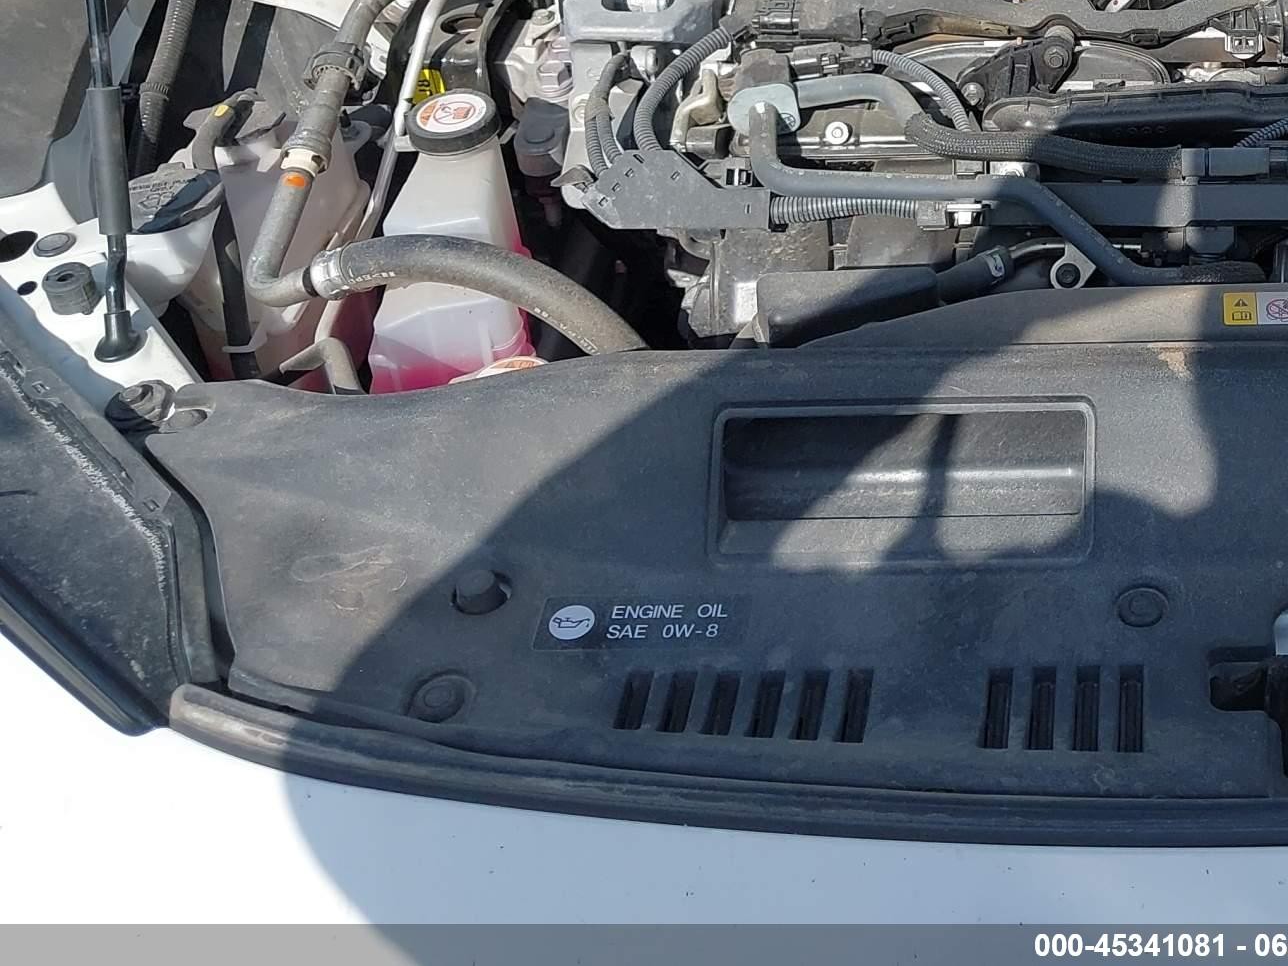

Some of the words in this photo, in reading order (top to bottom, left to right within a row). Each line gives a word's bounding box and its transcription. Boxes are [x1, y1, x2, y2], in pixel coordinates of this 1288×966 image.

[611, 604, 684, 619] ENGINE
[697, 604, 728, 618] OIL
[606, 624, 648, 639] SAE
[662, 623, 719, 638] 0W-8
